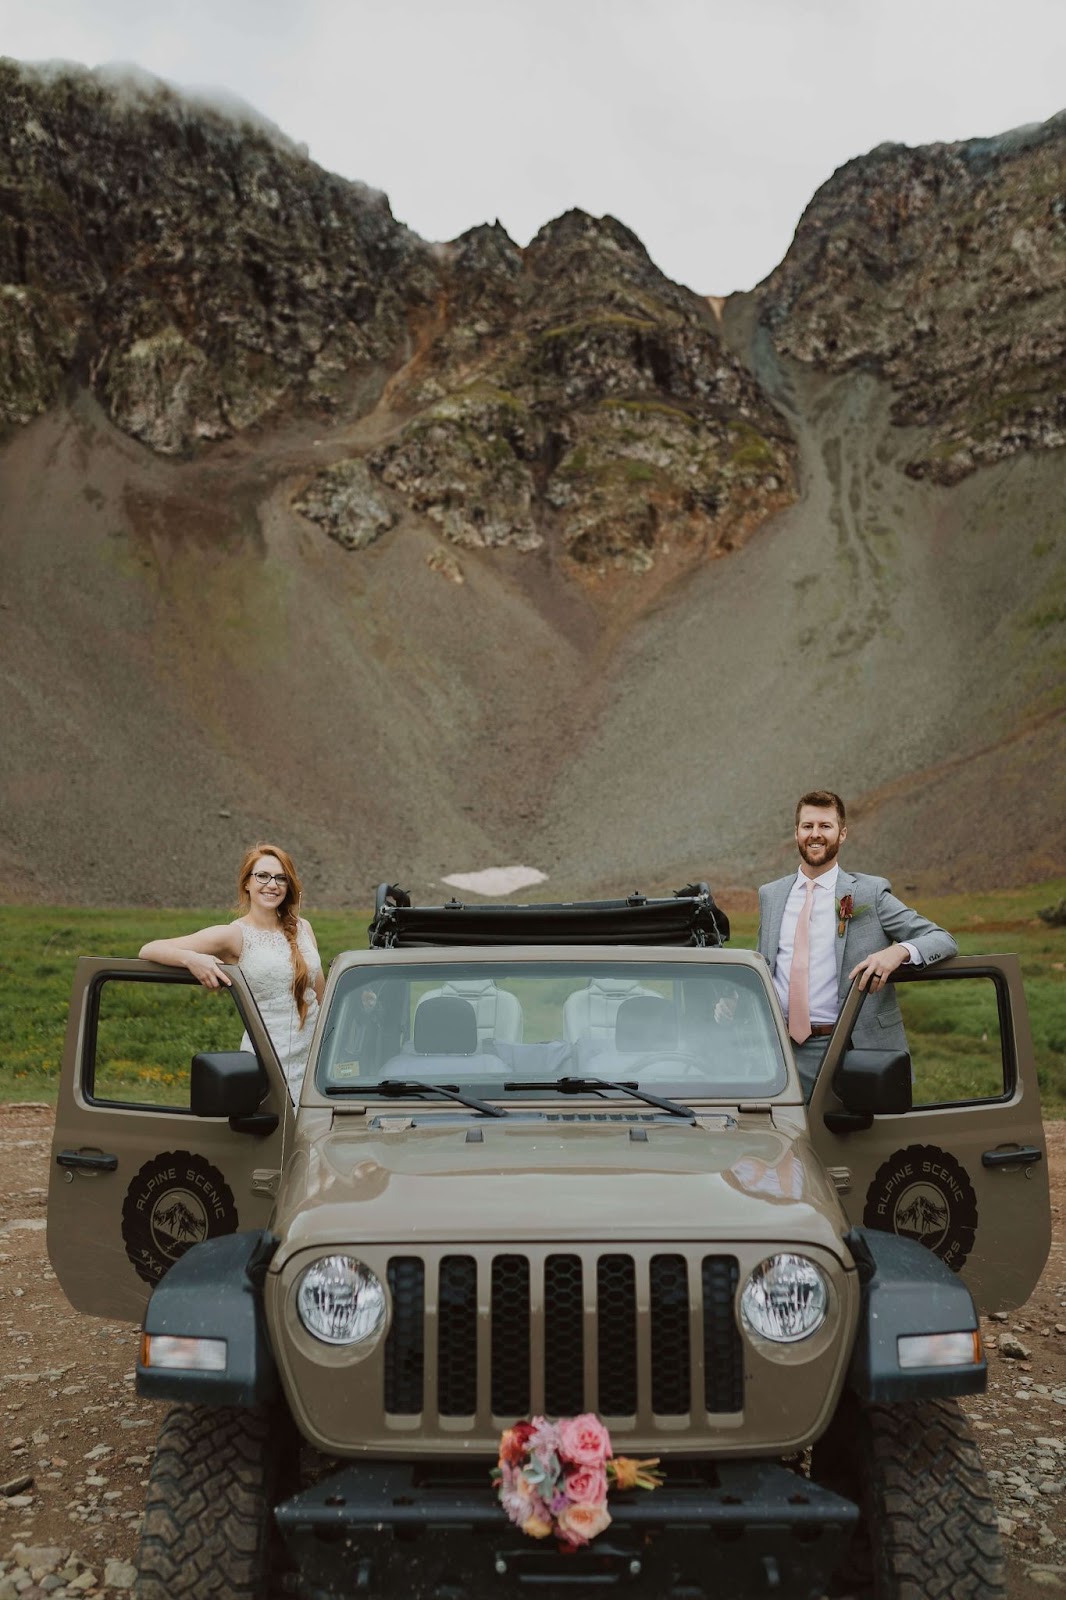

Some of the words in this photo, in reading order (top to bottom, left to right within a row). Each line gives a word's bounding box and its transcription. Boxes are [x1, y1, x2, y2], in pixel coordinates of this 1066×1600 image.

[136, 1168, 177, 1211] ALPINE
[186, 1169, 225, 1220] SCENIC
[877, 1164, 914, 1215] ALPINE
[922, 1161, 964, 1202] SCENIC
